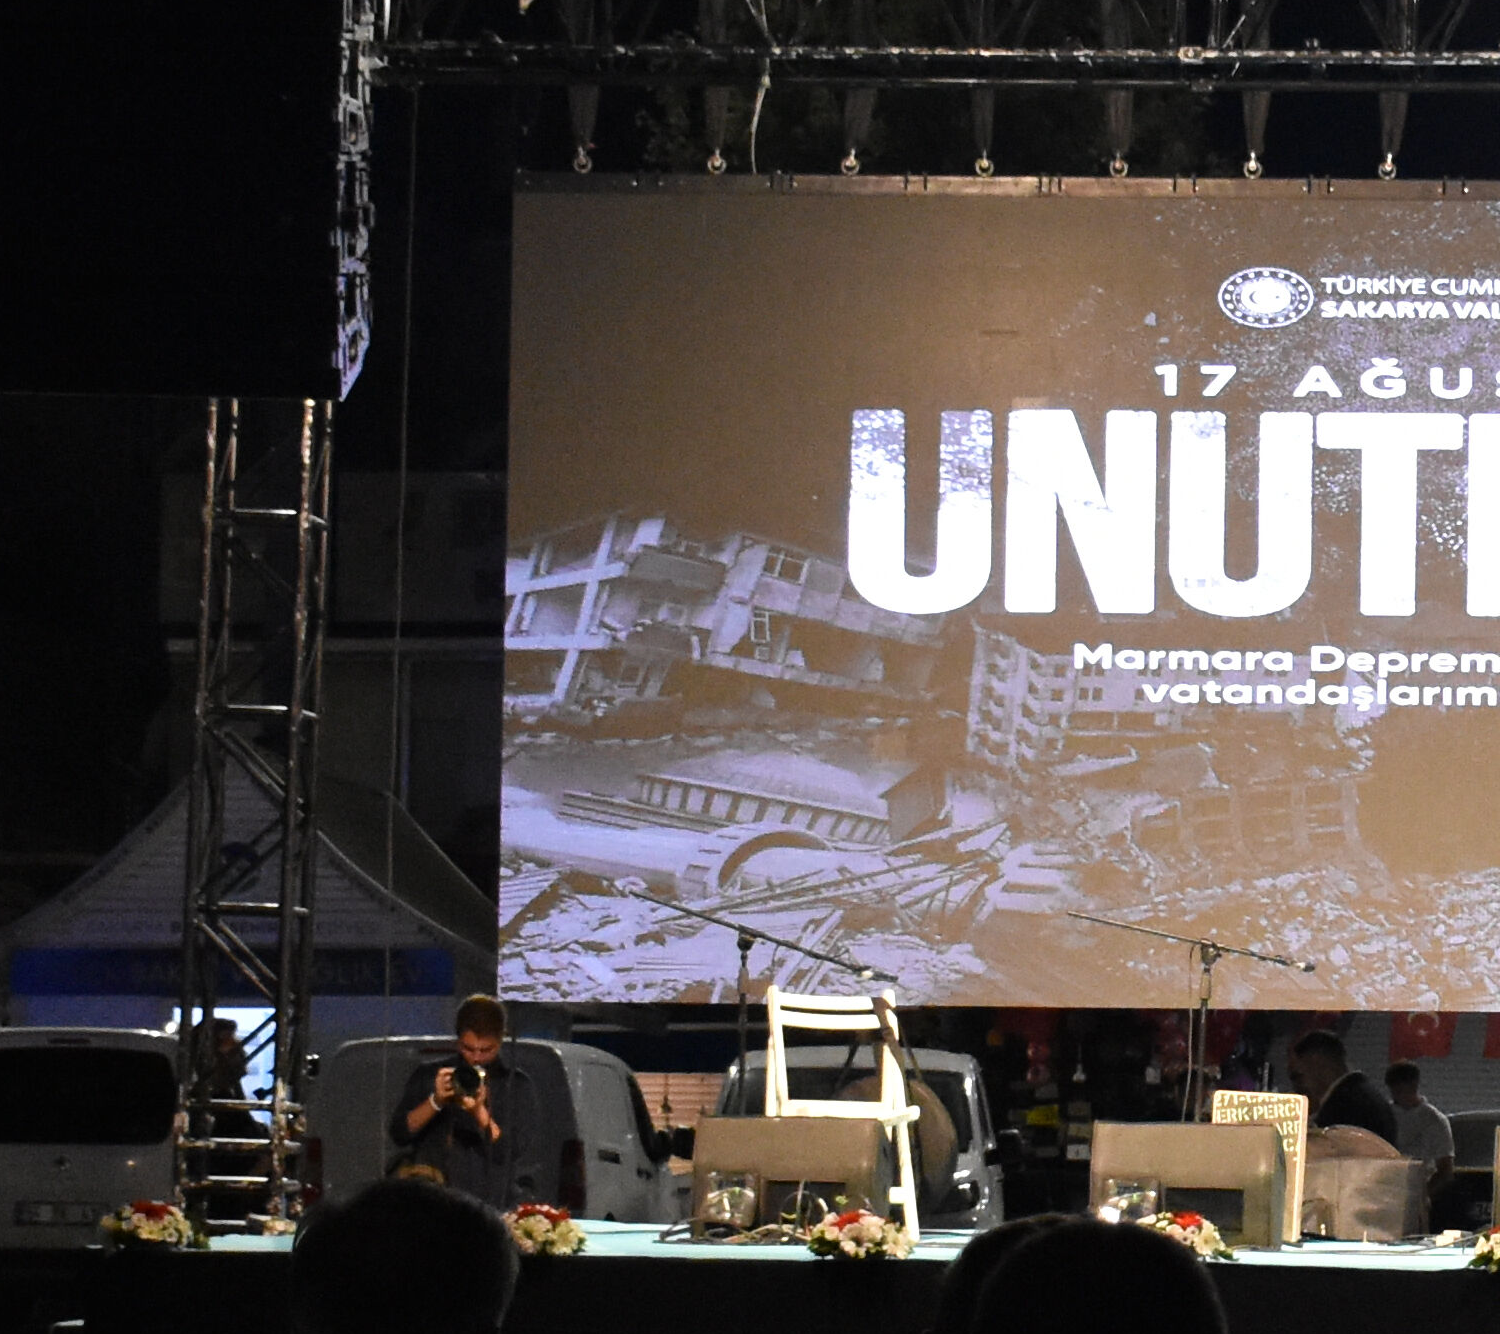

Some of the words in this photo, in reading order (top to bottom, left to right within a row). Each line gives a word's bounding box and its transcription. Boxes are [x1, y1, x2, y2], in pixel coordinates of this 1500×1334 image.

[1320, 274, 1427, 295] TÜRKİYE
[1320, 301, 1450, 319] SAKARYA
[1154, 363, 1237, 398] 17
[1073, 643, 1294, 672] Marmara
